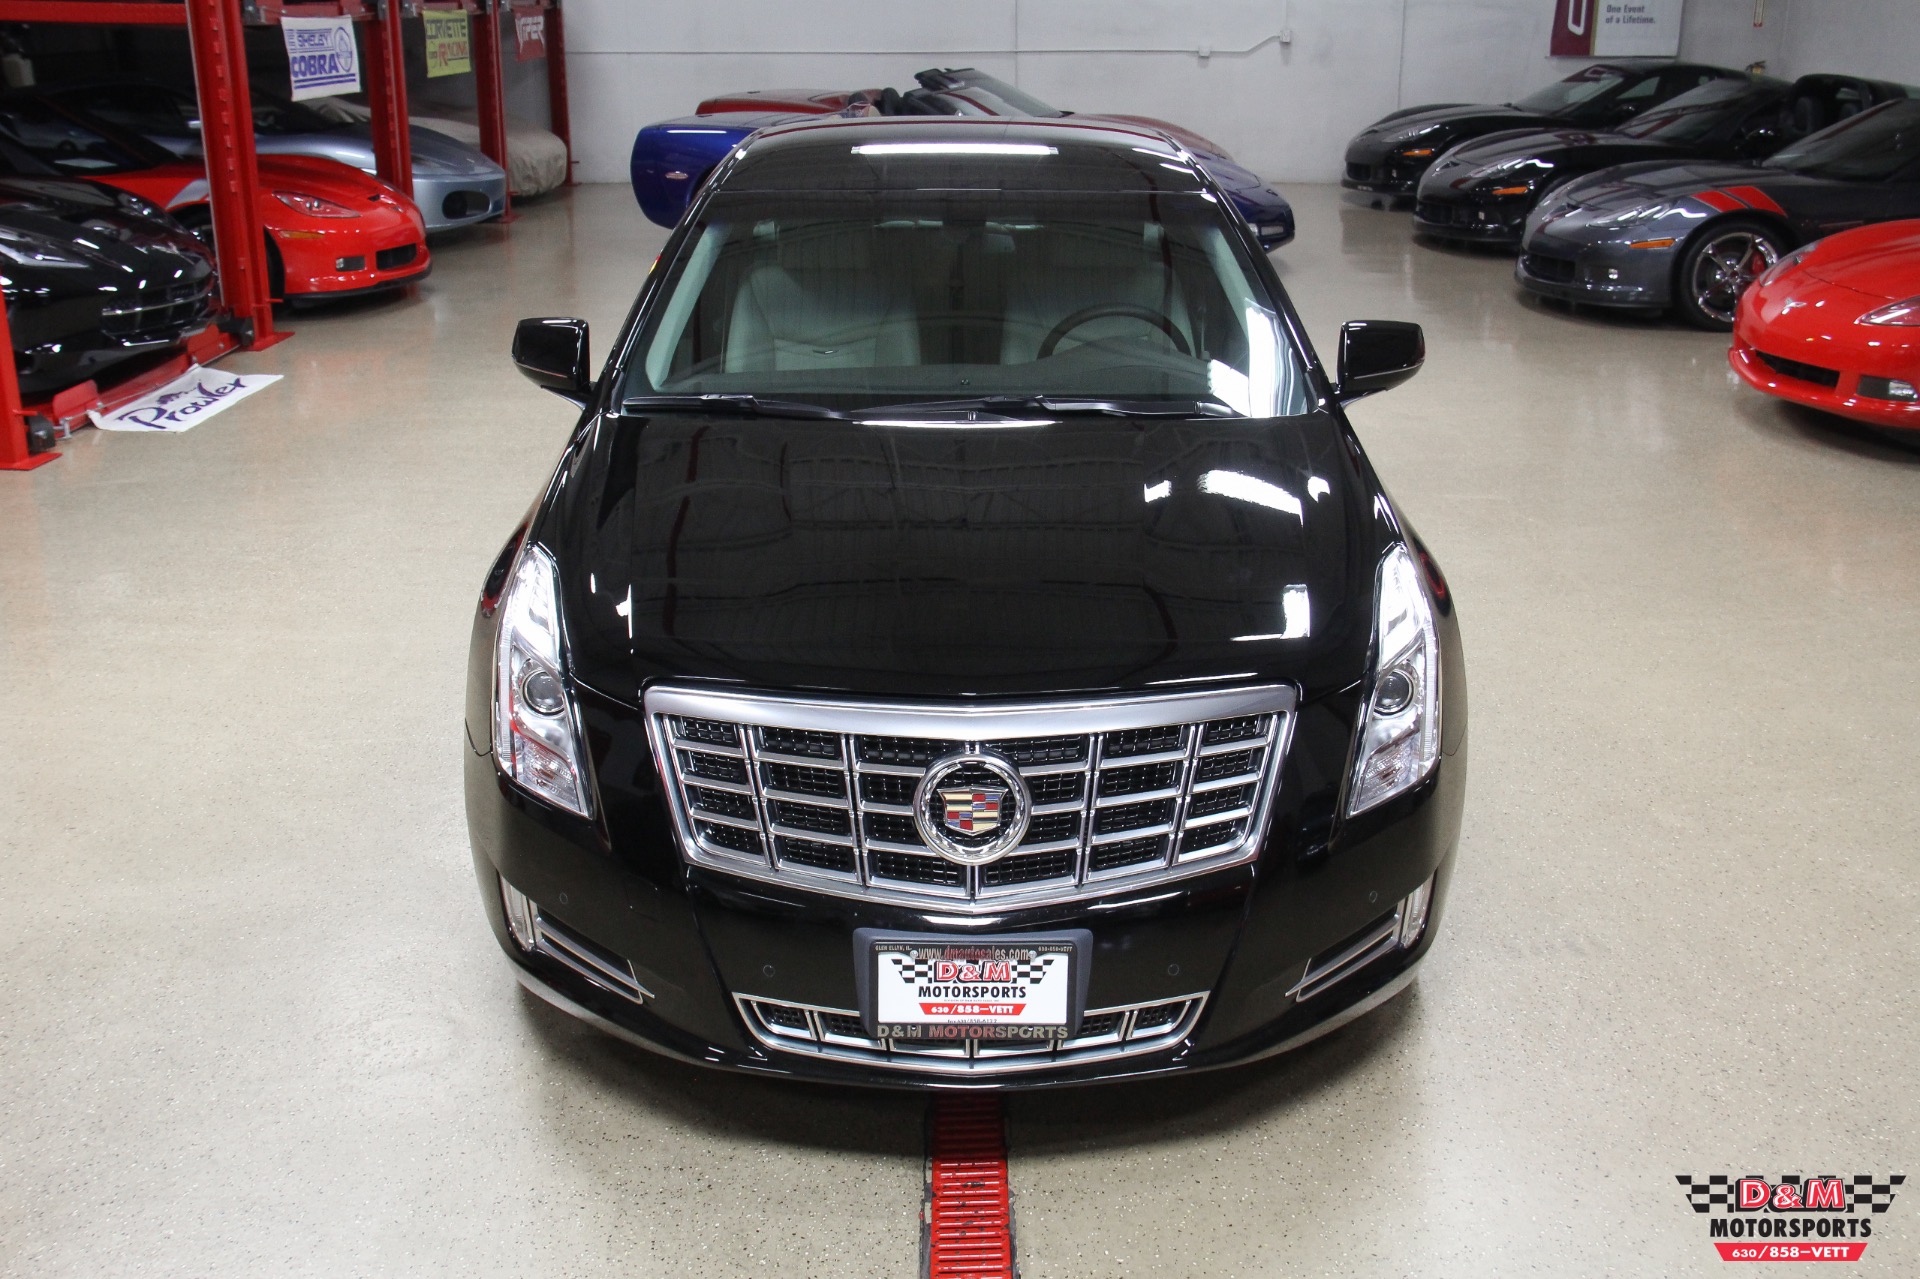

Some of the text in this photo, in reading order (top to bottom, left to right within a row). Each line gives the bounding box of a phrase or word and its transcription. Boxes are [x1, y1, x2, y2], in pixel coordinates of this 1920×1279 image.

[1606, 4, 1645, 13] One Event
[1605, 15, 1613, 24] of
[1622, 15, 1656, 24] Lifetime.
[425, 18, 466, 39] CORVETTE
[515, 16, 544, 53] VIPER
[297, 33, 331, 47] SHELBY
[291, 53, 340, 78] COBRA
[115, 377, 247, 430] Prowler
[934, 960, 1013, 984] D&M
[918, 986, 1026, 998] MOTORSPORTS
[877, 1025, 1069, 1039] D&M MOTORSPORTS
